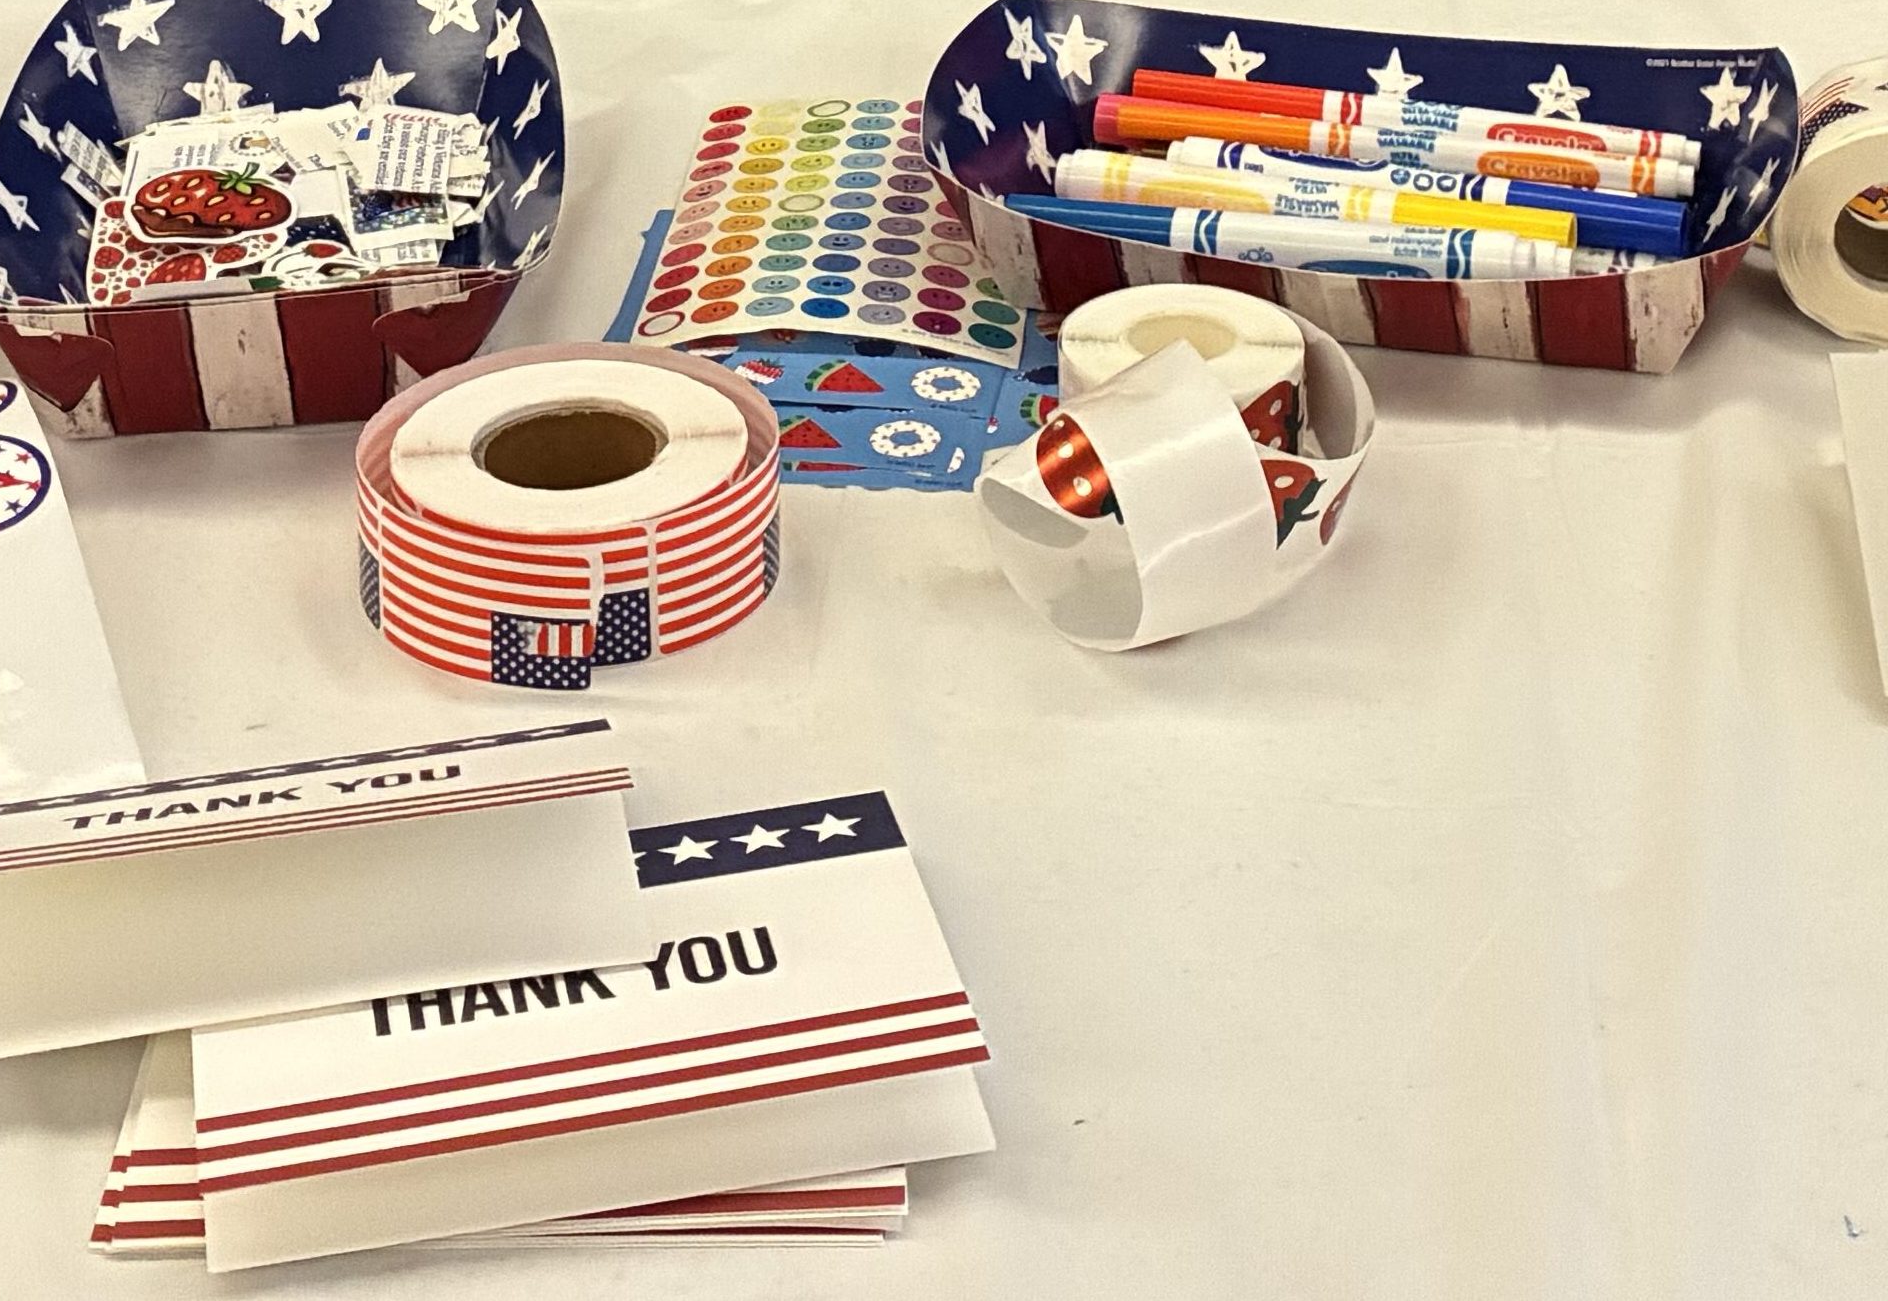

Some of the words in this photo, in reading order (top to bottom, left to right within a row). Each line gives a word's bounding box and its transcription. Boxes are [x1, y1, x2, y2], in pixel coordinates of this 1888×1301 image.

[1493, 124, 1594, 154] Crayola
[1491, 156, 1585, 183] Crayola
[63, 788, 306, 830] THANK
[325, 765, 462, 797] YOU
[372, 960, 617, 1038] THANK
[640, 926, 779, 992] YOU
